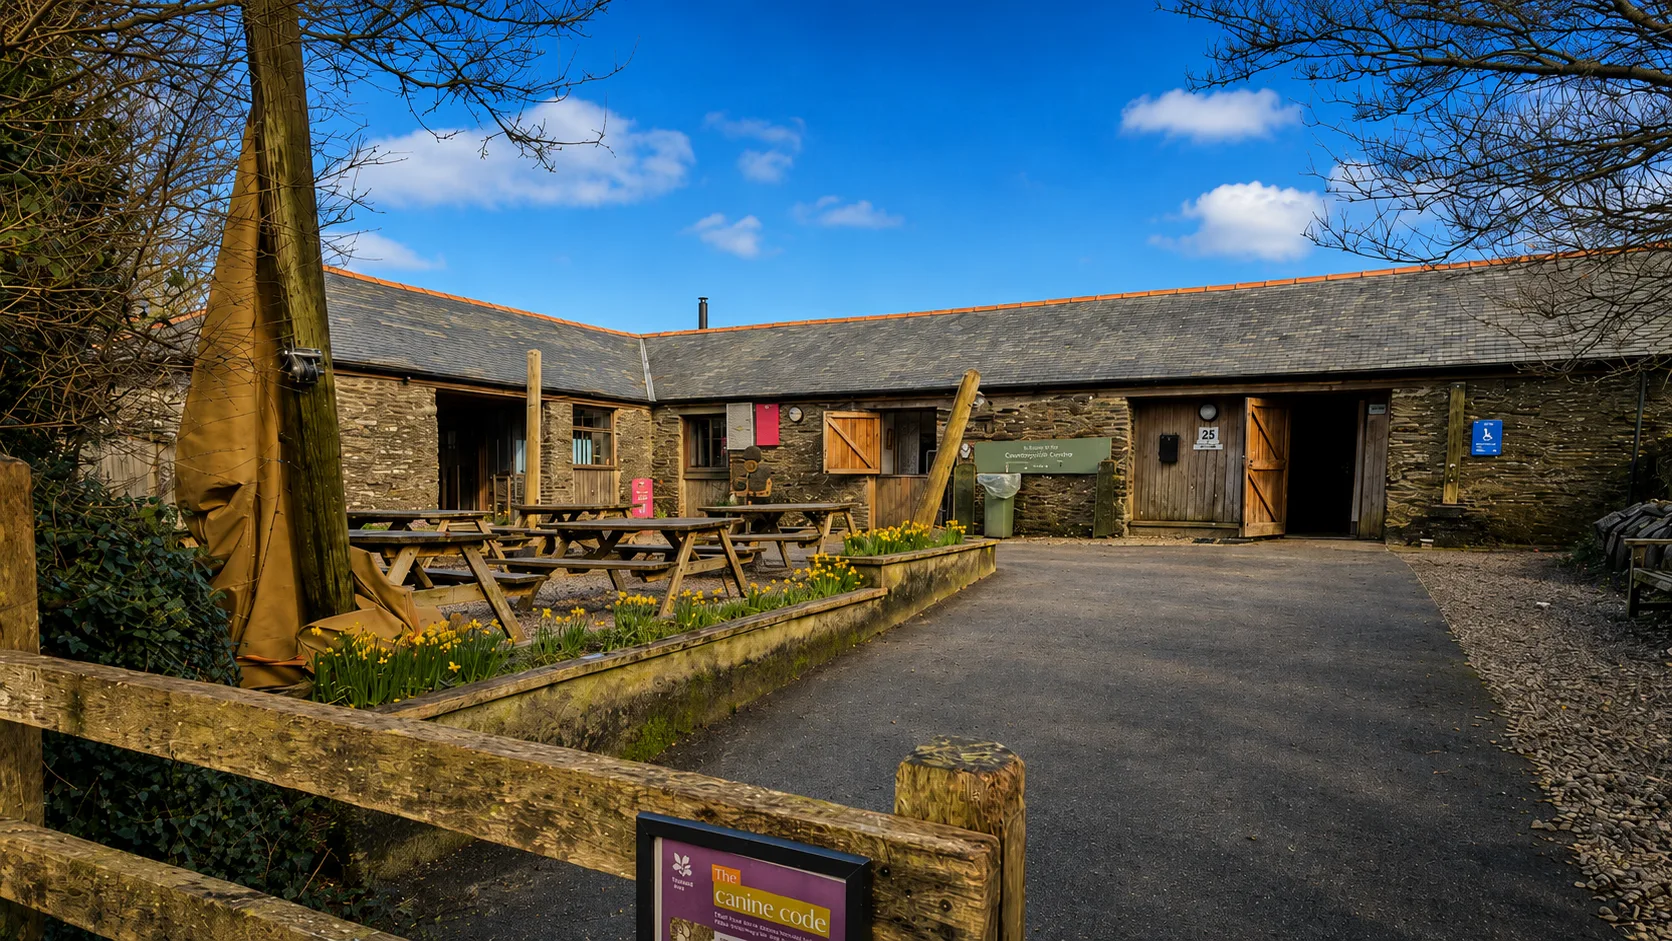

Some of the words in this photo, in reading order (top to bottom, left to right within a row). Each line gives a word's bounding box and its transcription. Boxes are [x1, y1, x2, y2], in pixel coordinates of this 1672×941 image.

[1202, 429, 1215, 440] 25
[714, 868, 737, 884] The
[715, 889, 774, 918] canine
[779, 908, 827, 933] code
